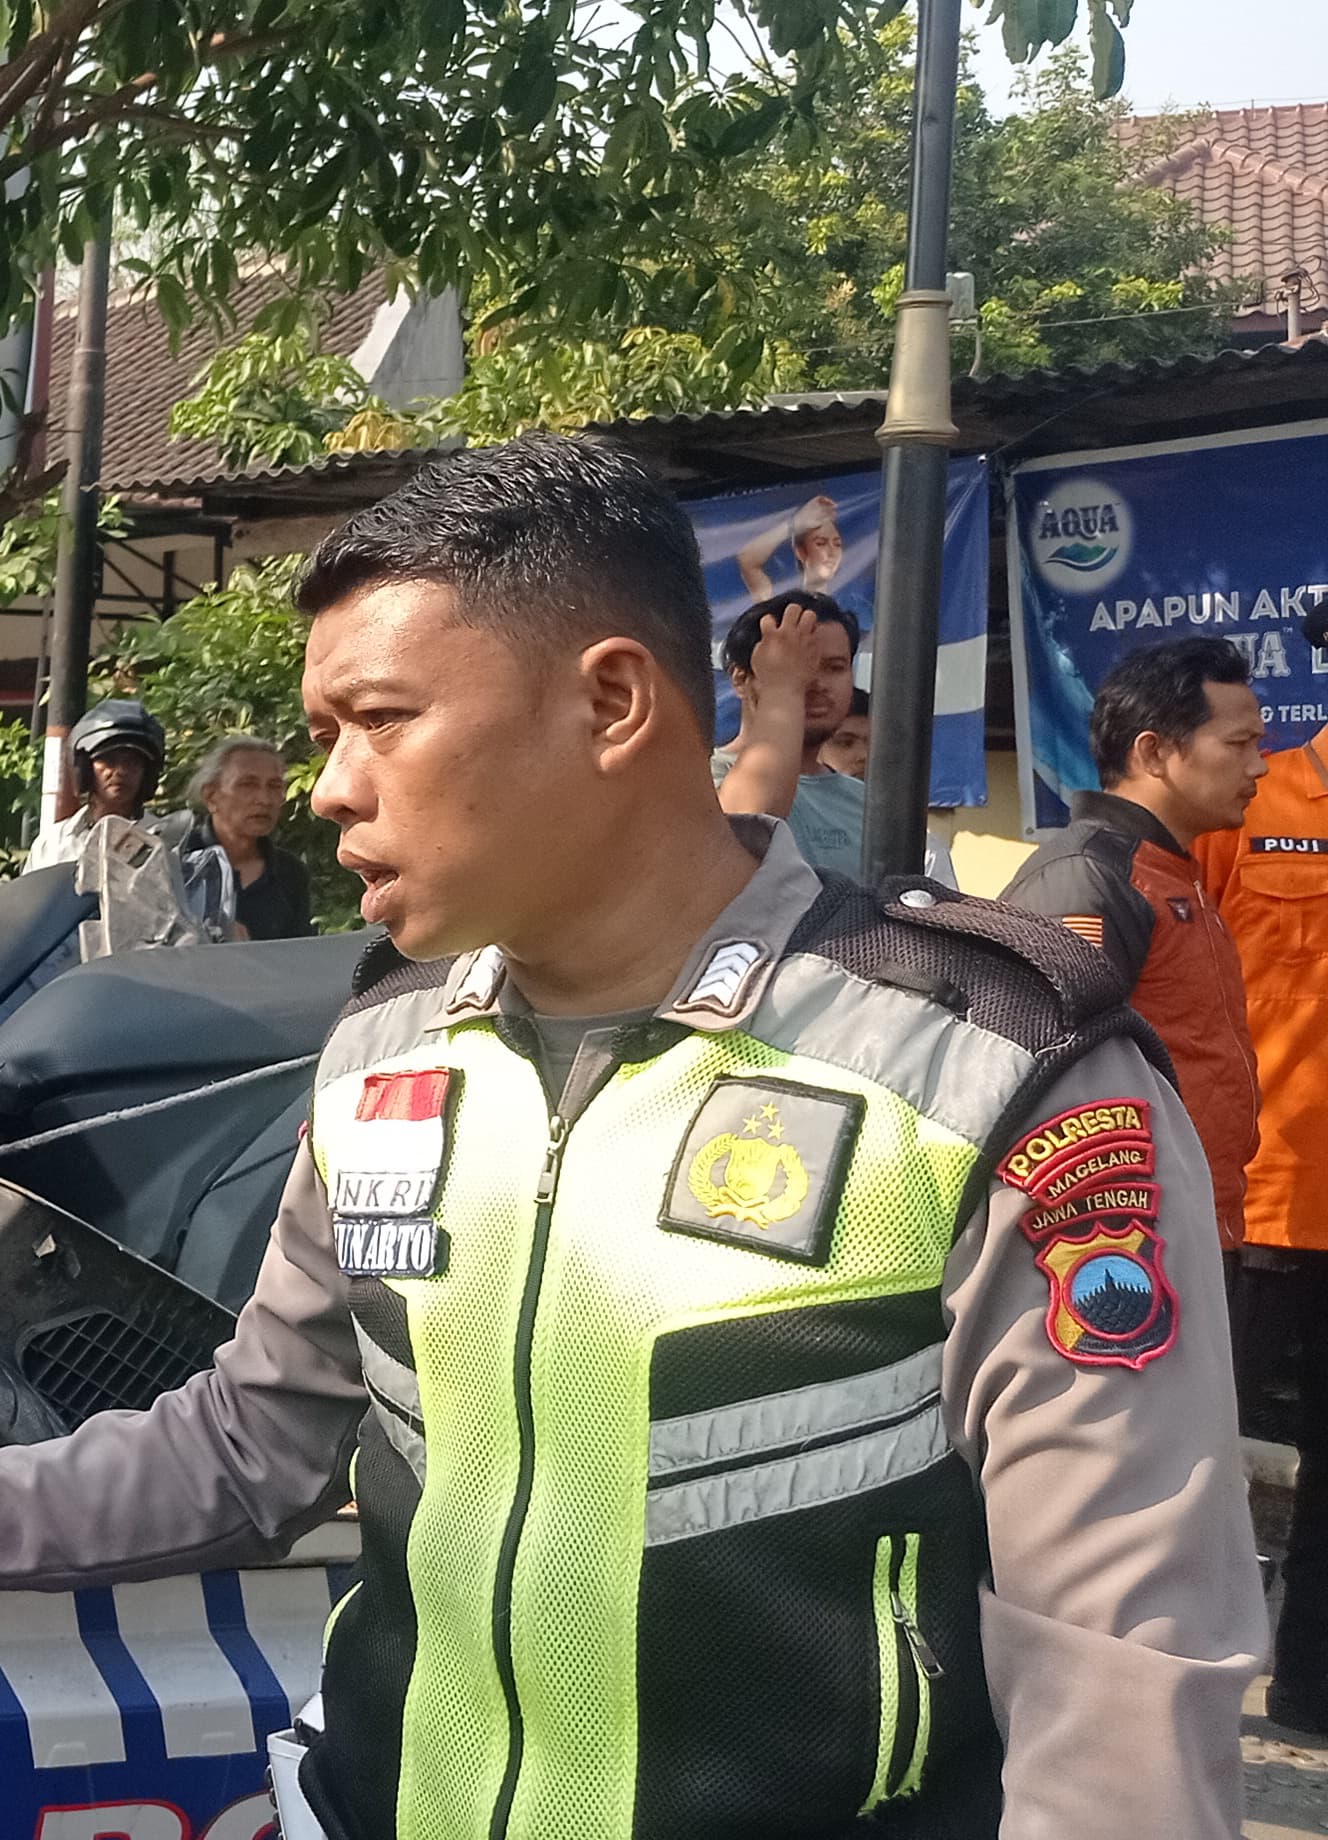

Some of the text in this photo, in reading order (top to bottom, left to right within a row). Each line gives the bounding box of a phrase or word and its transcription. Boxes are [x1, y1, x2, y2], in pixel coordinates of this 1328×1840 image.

[1039, 504, 1120, 541] AQUA
[1089, 591, 1240, 632] APAPUN
[1264, 838, 1320, 853] PUJI
[1008, 1106, 1141, 1177] POLRESTA
[342, 1179, 426, 1208] NKRI
[1047, 1149, 1145, 1199] MAGELANG
[1032, 1190, 1149, 1230] JAWA TENGAH
[334, 1222, 432, 1272] UNARTO
